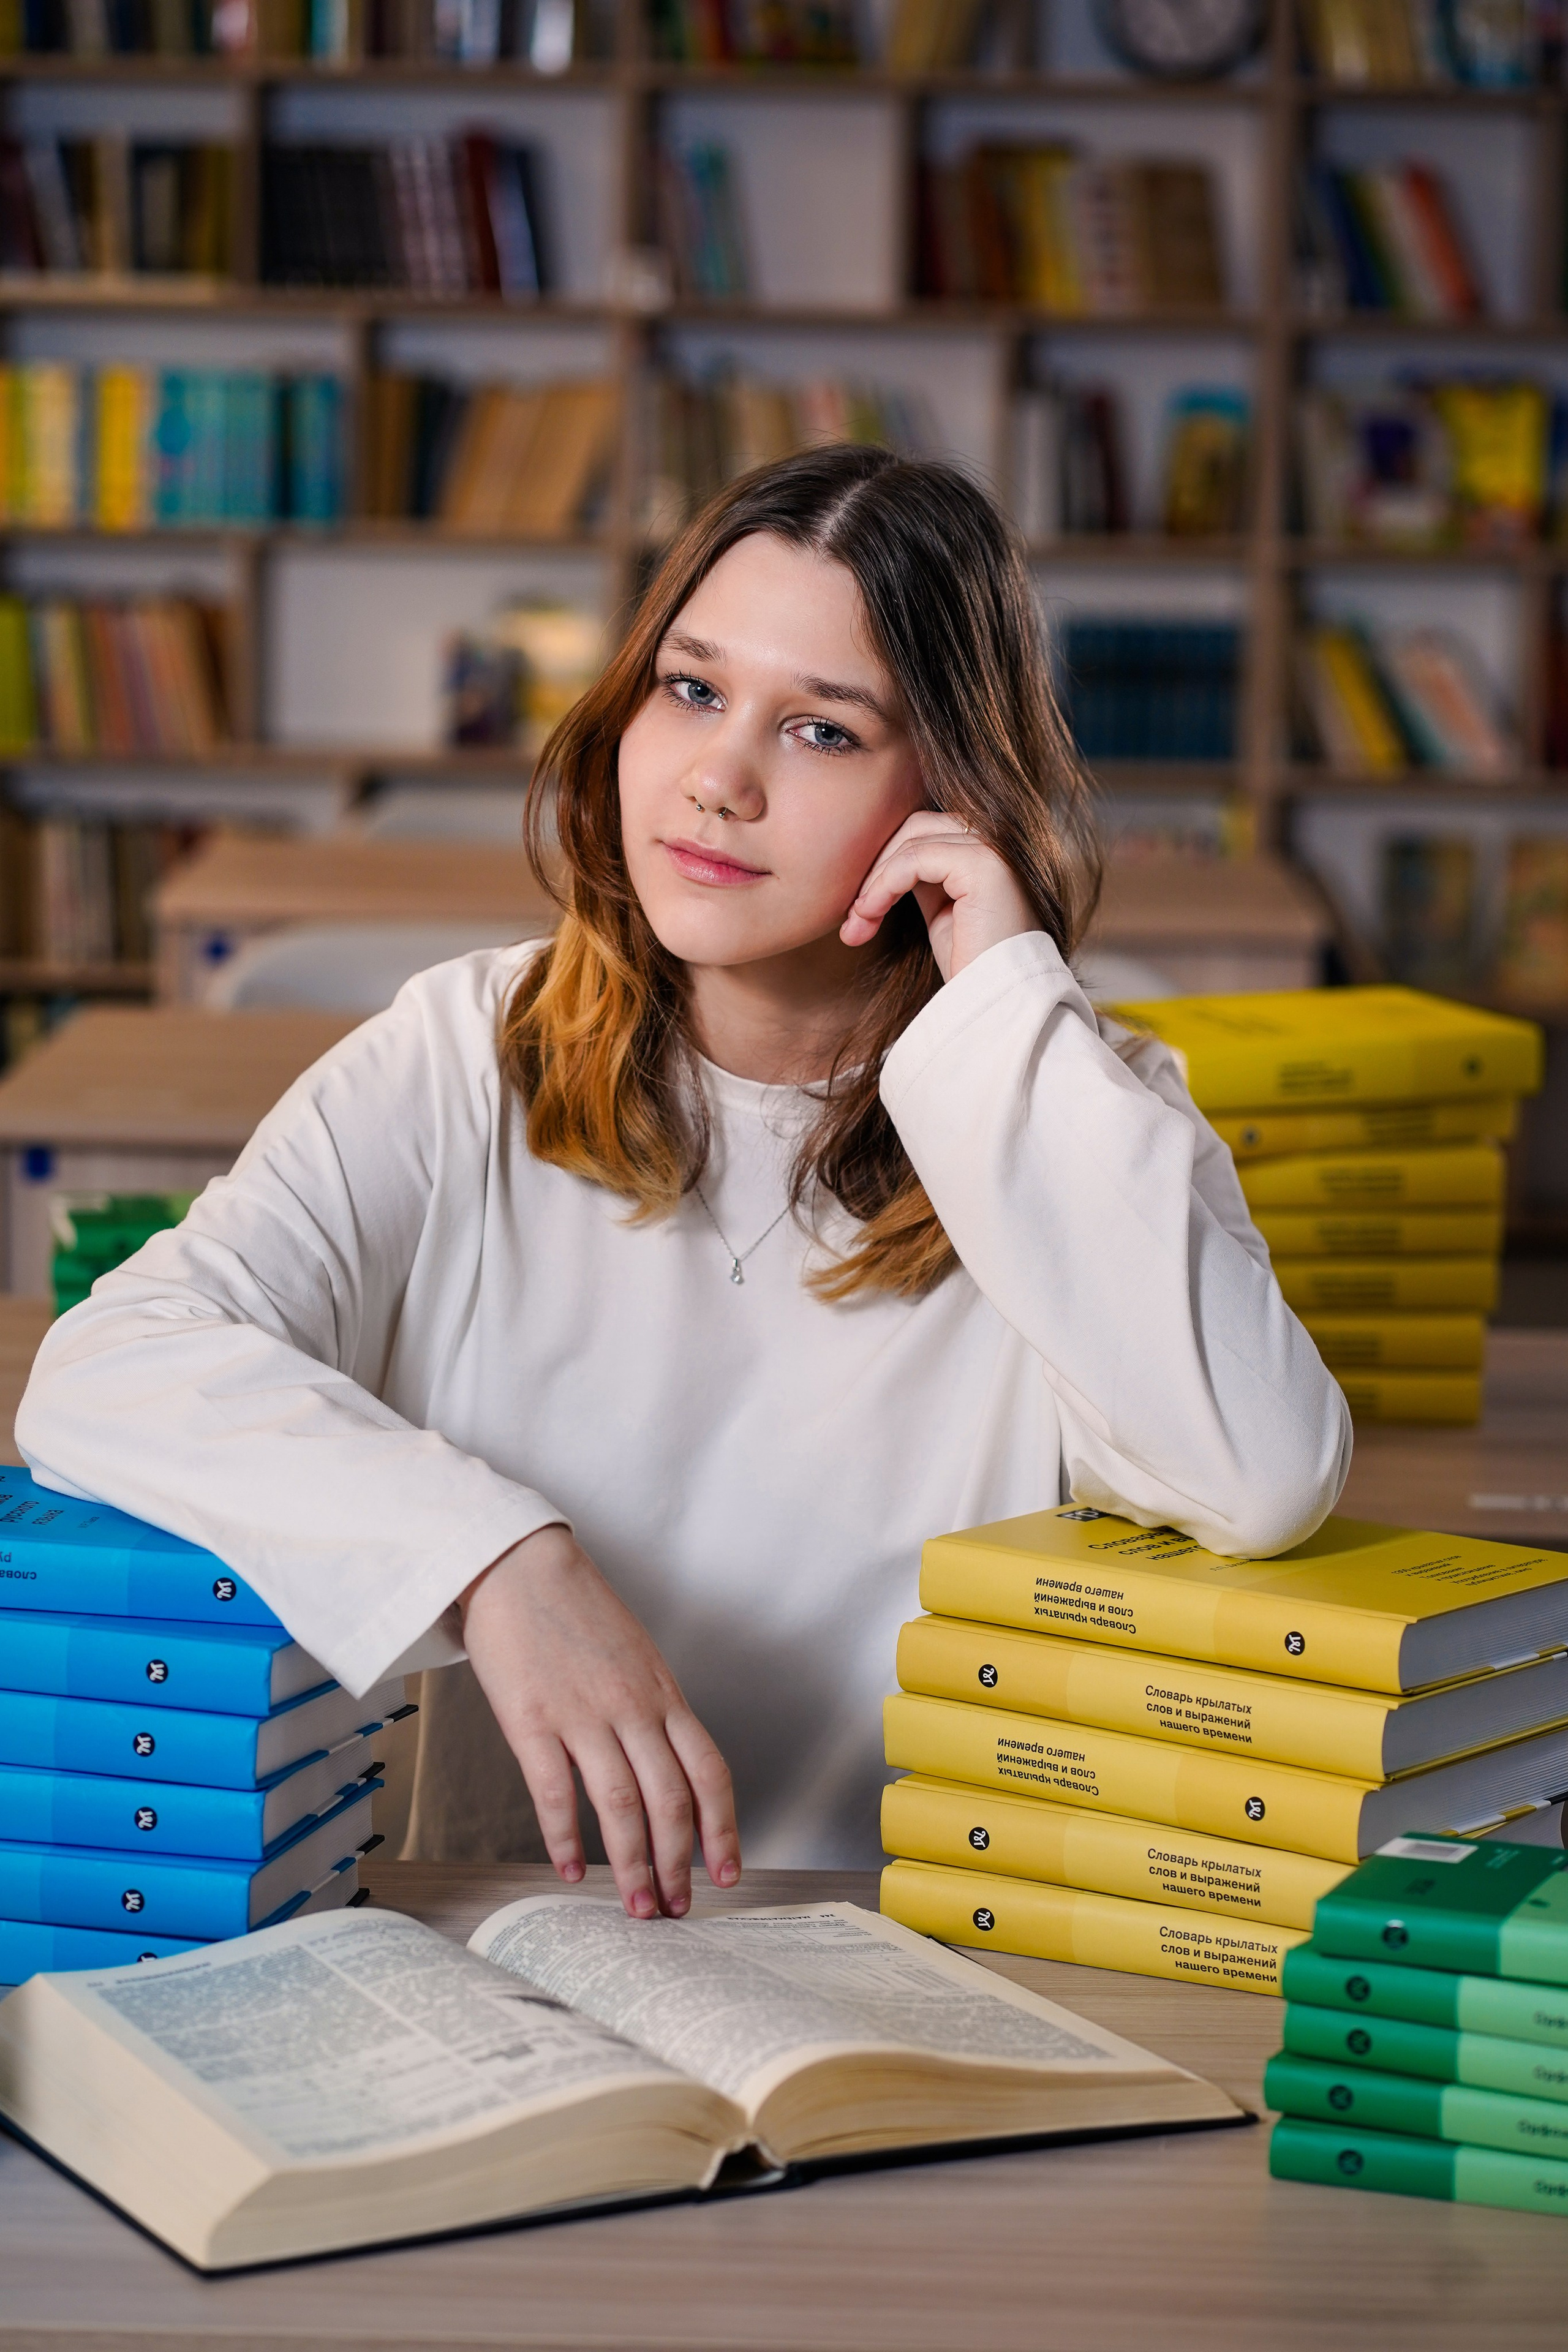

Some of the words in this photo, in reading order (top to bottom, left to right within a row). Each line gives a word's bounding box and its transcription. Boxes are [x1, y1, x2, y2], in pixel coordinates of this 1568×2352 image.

[0, 1501, 40, 1523] русского
[32, 1509, 65, 1525] языка
[1088, 1531, 1164, 1551] Словарь
[1118, 1541, 1160, 1556] слов
[1161, 1539, 1172, 1548] и
[1036, 1577, 1082, 1593] времени
[1085, 1586, 1124, 1600] нашего
[1034, 1593, 1096, 1610] выражений
[1099, 1604, 1105, 1612] и
[1034, 1607, 1087, 1623] крылатых
[1107, 1605, 1134, 1617] слов
[1090, 1616, 1136, 1634] Словарь
[1145, 1685, 1193, 1704] Словарь
[1196, 1696, 1252, 1714] крылатых
[1147, 1703, 1173, 1715] слов
[1175, 1708, 1182, 1717] и
[1185, 1709, 1251, 1730] выражений
[1159, 1719, 1200, 1733] нашего
[1203, 1727, 1253, 1744] времени
[998, 1738, 1044, 1754] времени
[1046, 1747, 1085, 1762] нашего
[997, 1752, 1058, 1772] выражений
[997, 1766, 1051, 1784] крылатых
[1071, 1767, 1096, 1779] слов
[1053, 1777, 1099, 1796] Словарь
[1148, 1848, 1198, 1868] Словарь
[1201, 1860, 1262, 1878] крылатых
[1149, 1866, 1177, 1878] слов
[1180, 1871, 1187, 1880] и
[1190, 1873, 1261, 1893] выражений
[1163, 1883, 1205, 1897] нашего
[1208, 1891, 1261, 1907] времени
[1159, 1926, 1212, 1945] Словарь
[1215, 1936, 1278, 1954] крылатых
[1161, 1943, 1190, 1956] слов
[1193, 1948, 1200, 1958] и
[1204, 1950, 1276, 1969] выражений
[1175, 1961, 1220, 1974] нашего
[1223, 1967, 1278, 1983] времени
